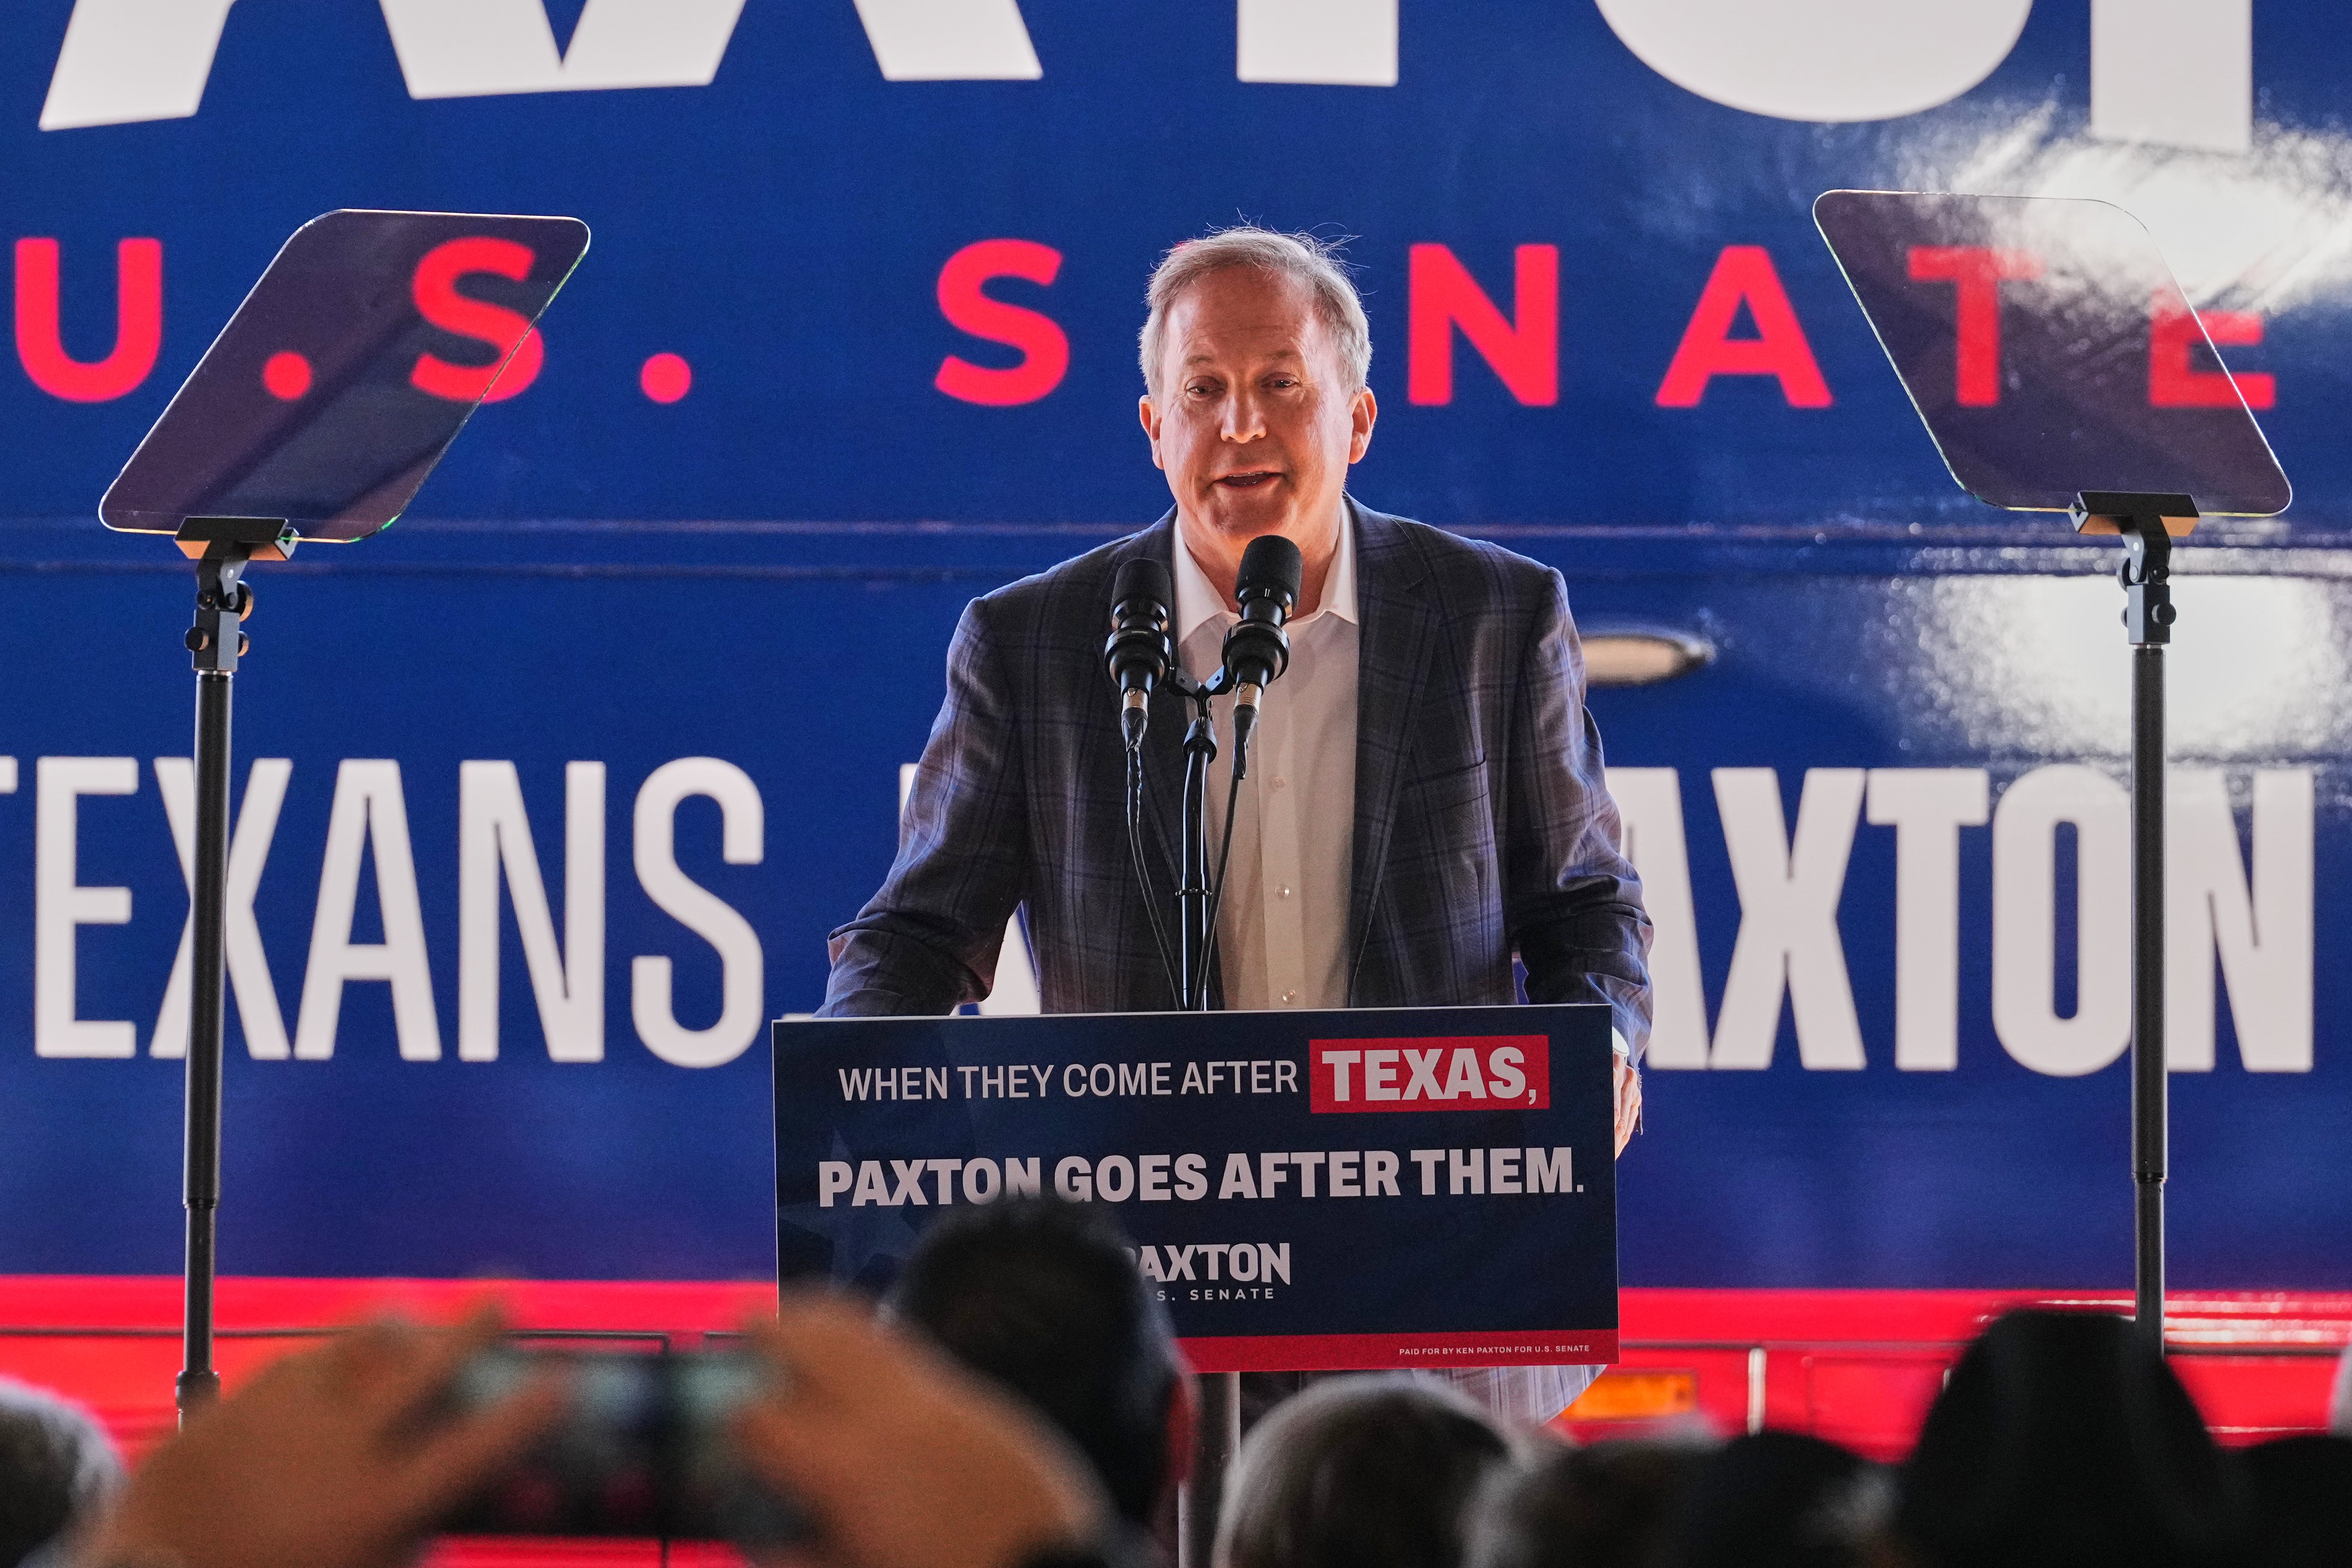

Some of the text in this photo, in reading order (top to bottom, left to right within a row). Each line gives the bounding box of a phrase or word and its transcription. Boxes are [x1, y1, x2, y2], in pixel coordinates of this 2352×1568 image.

[935, 237, 2277, 410] SNATE
[0, 755, 766, 1069] EXANS
[1604, 763, 2315, 1077] AXTON
[838, 1046, 1537, 1105] WHEN THEY COME AFTER TEXAS,
[819, 1146, 1584, 1207] PAXTON GOES AFTER THEM.
[1124, 1243, 1291, 1286] AXTON
[1189, 1288, 1274, 1301] SENATE
